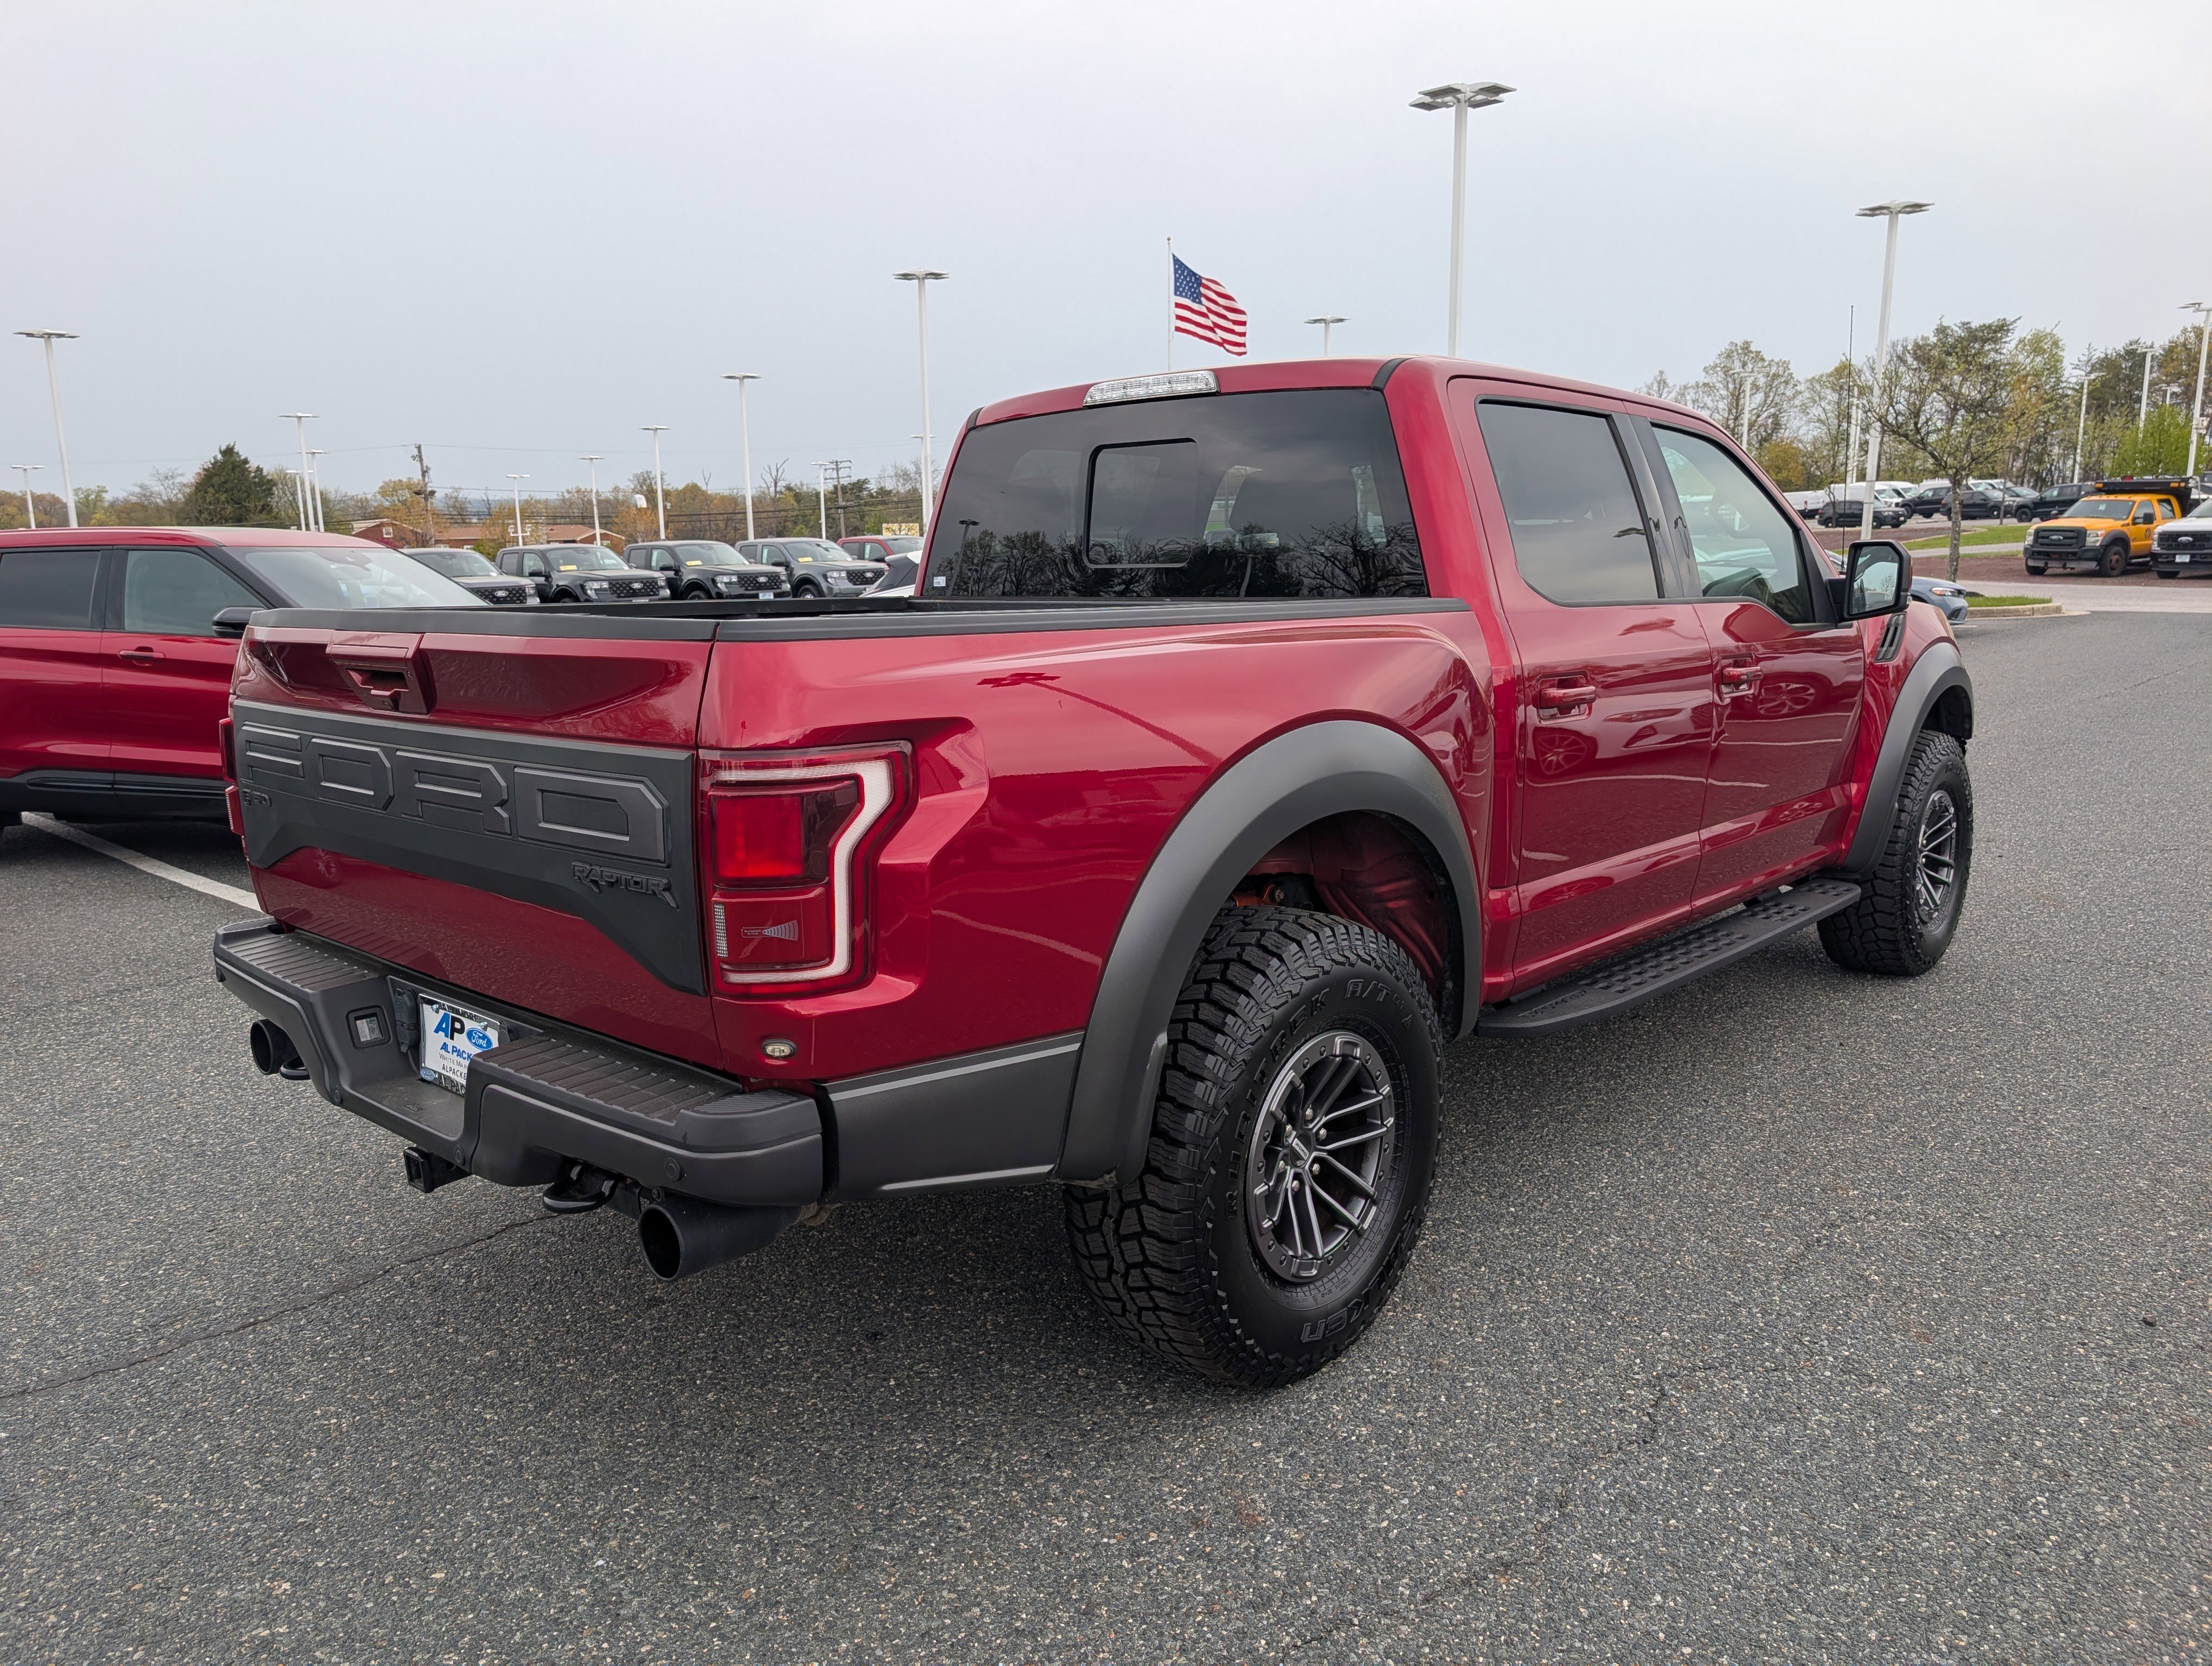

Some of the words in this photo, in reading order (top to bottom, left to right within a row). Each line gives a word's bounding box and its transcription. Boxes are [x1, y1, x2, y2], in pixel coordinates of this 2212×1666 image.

[240, 722, 670, 867] FORD
[571, 861, 679, 912] RAPTOR
[438, 1003, 480, 1022] BALTIMORE
[433, 1012, 466, 1041] AP
[440, 1041, 451, 1054] AL
[471, 1031, 487, 1047] Ford
[439, 1053, 455, 1065] WHITE
[1226, 988, 1330, 1219] RUBITREK
[1296, 1143, 1308, 1157] FORD
